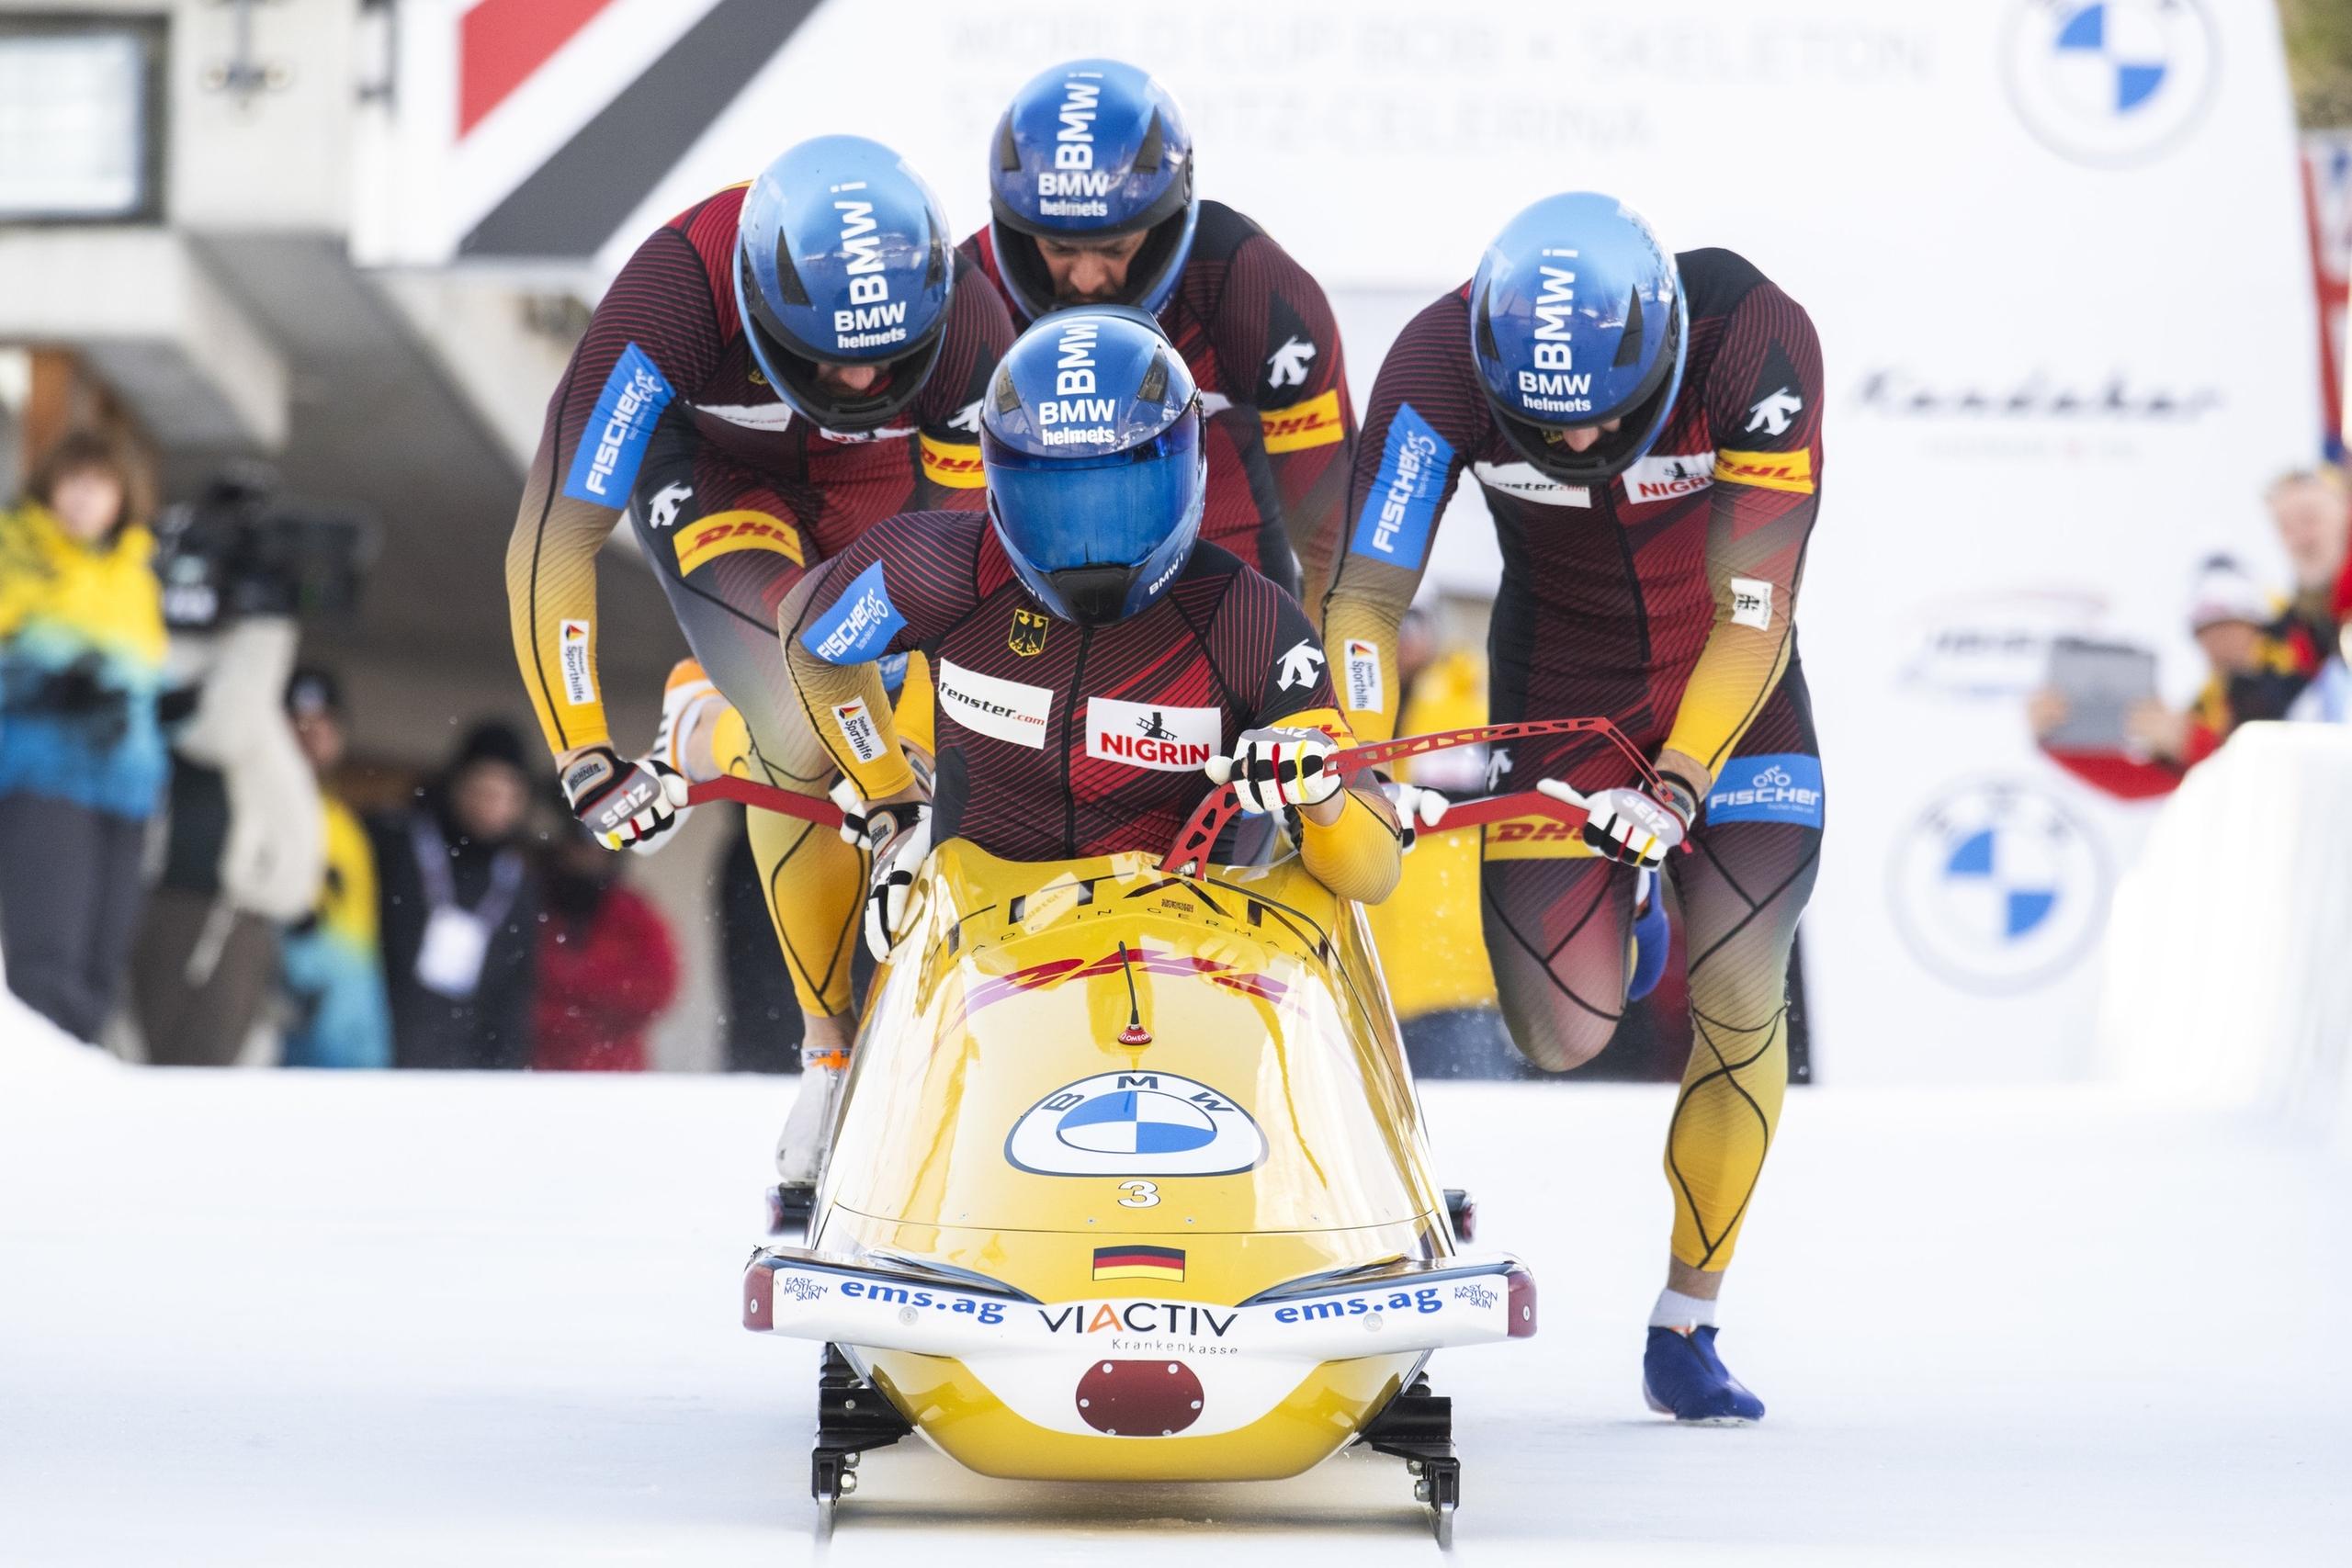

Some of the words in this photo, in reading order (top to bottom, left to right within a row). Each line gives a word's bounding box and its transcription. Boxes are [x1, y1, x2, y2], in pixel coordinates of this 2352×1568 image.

[1055, 83, 1101, 170] BMW
[1038, 173, 1110, 197] BMW
[1040, 197, 1108, 217] helmets
[834, 201, 888, 305] BMW
[834, 301, 907, 332] BMW
[1534, 265, 1576, 370] BMW
[838, 327, 907, 349] helmets
[1057, 323, 1099, 396] BMW
[1519, 370, 1591, 396] BMW
[1039, 399, 1115, 434] BMW
[1522, 393, 1591, 412] helmets
[1042, 425, 1114, 446] helmets
[1262, 413, 1325, 438] DHL
[1638, 477, 1709, 498] NIGR
[695, 523, 797, 550] DHL
[1149, 564, 1179, 595] BMW
[844, 719, 873, 761] Sporthilfe
[1101, 732, 1209, 765] NIGRIN
[1042, 1076, 1235, 1114] BMW
[1117, 1180, 1160, 1208] 3
[784, 1281, 828, 1295] MOTION
[796, 1292, 820, 1301] SKIN
[841, 1281, 1008, 1325] ems.ag
[1274, 1288, 1442, 1324] ems.ag
[1470, 1297, 1492, 1310] SKIN
[1038, 1303, 1238, 1337] VIACTIV
[1112, 1338, 1238, 1355] Krankenkasse
